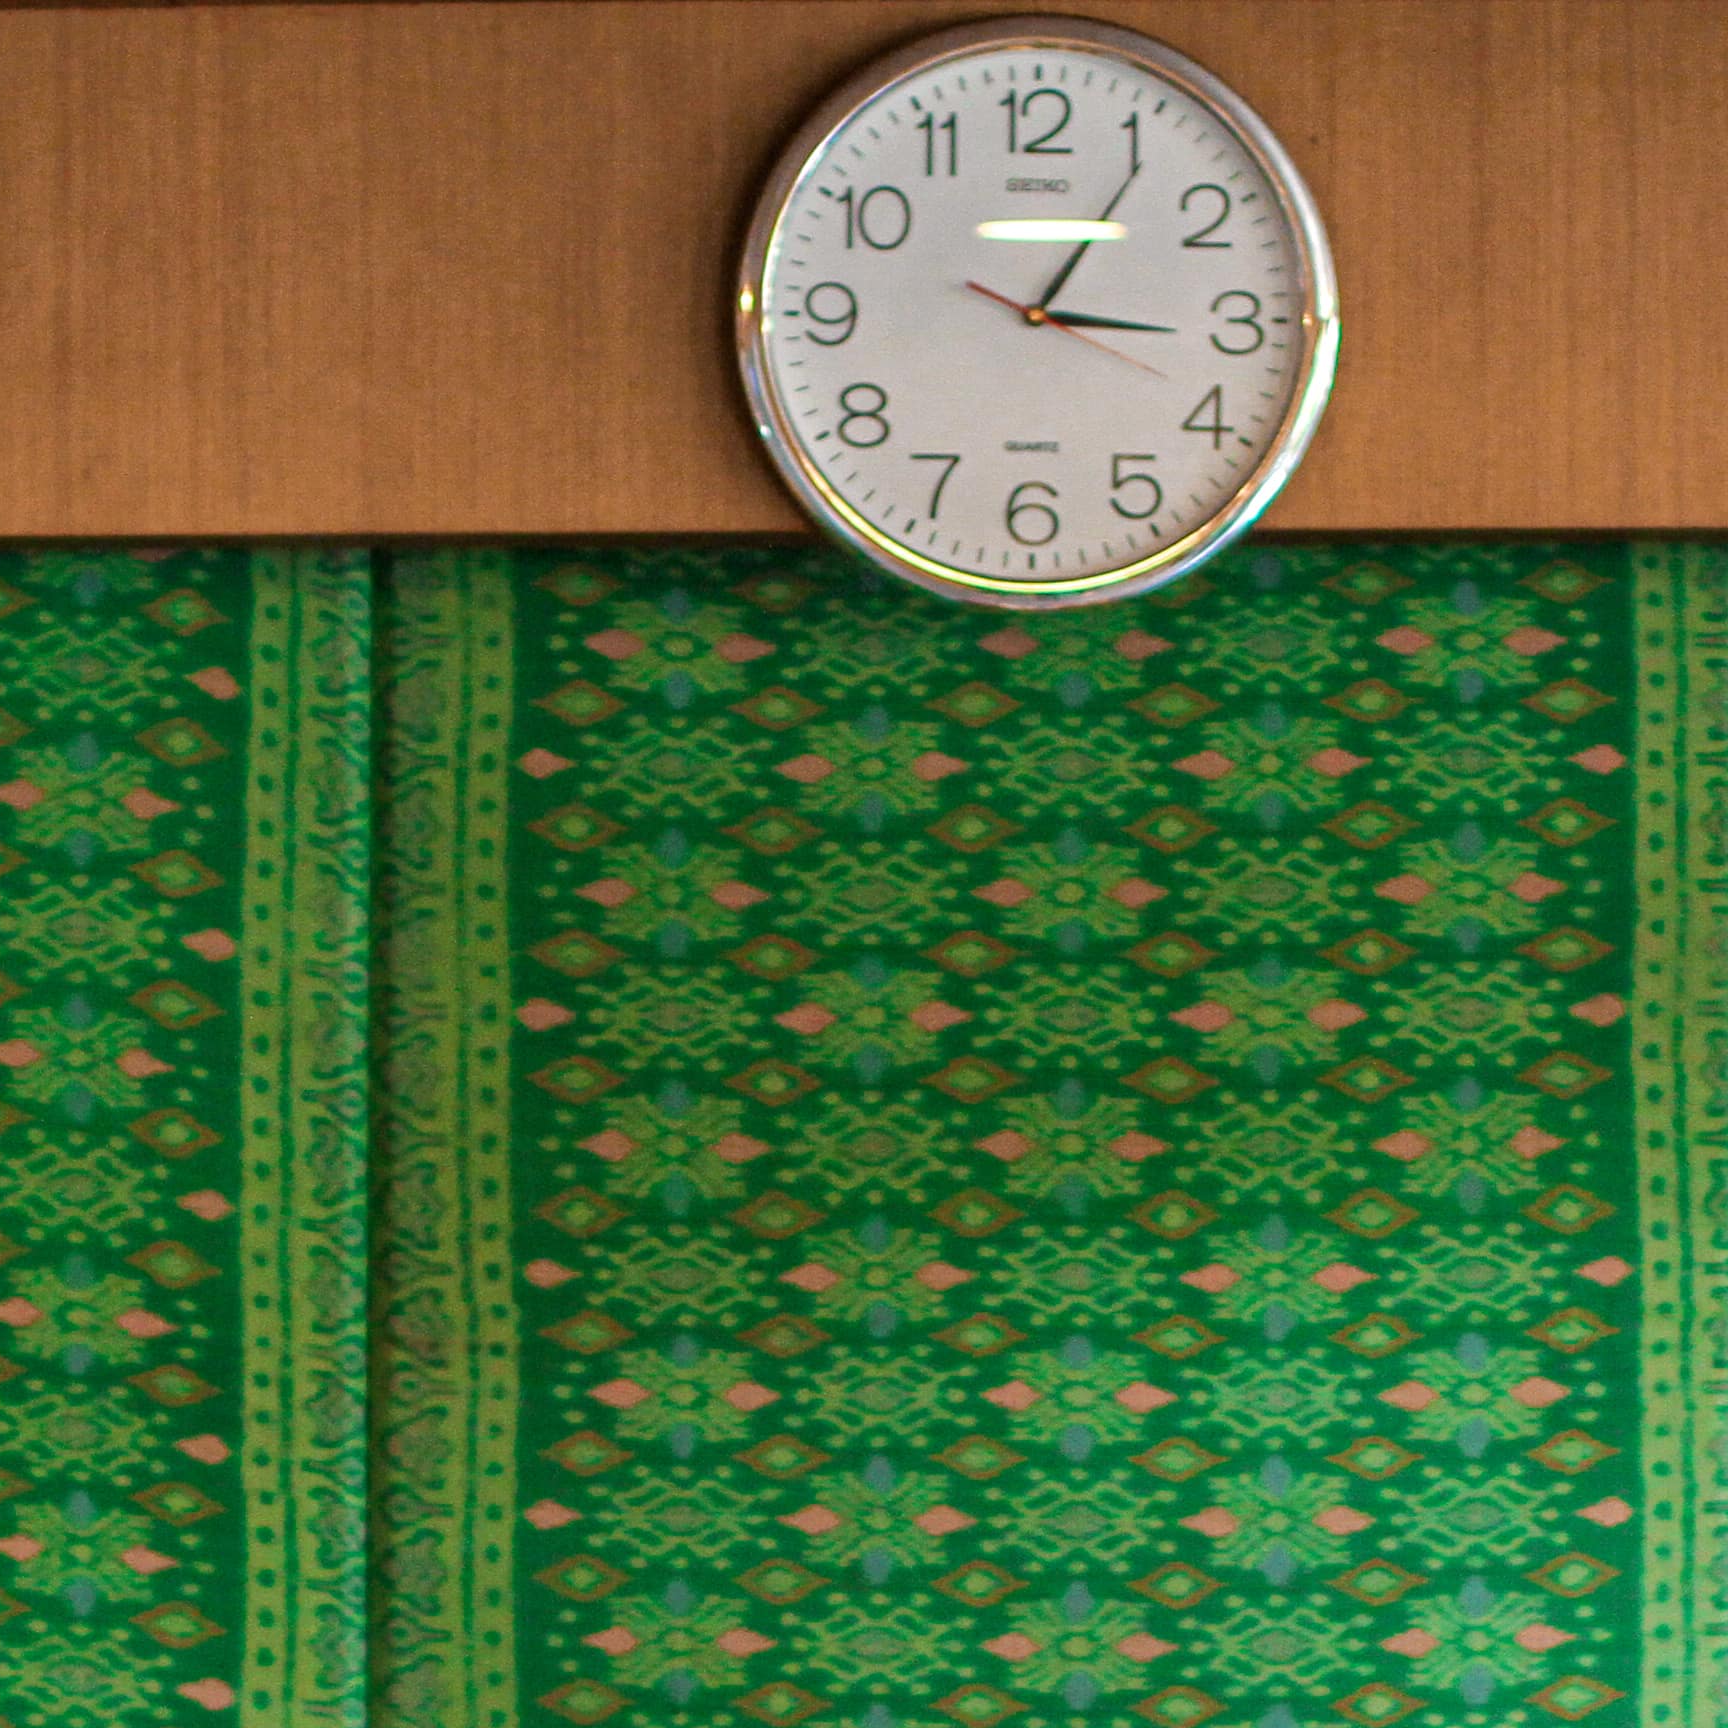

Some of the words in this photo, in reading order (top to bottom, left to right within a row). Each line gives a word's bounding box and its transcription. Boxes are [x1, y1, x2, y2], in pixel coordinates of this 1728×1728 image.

[917, 111, 958, 177] 11
[1000, 88, 1073, 154] 12
[1122, 111, 1140, 174] 1
[838, 185, 911, 250] 10
[1005, 177, 1070, 193] SEIKO
[1179, 183, 1232, 249] 2
[804, 281, 858, 346] 9
[1208, 290, 1265, 355] 3
[836, 382, 889, 448] 8
[1004, 439, 1060, 452] QUARTZ
[1181, 384, 1235, 450] 4
[909, 454, 961, 519] 7
[1006, 480, 1060, 546] 6
[1109, 455, 1163, 519] 5
